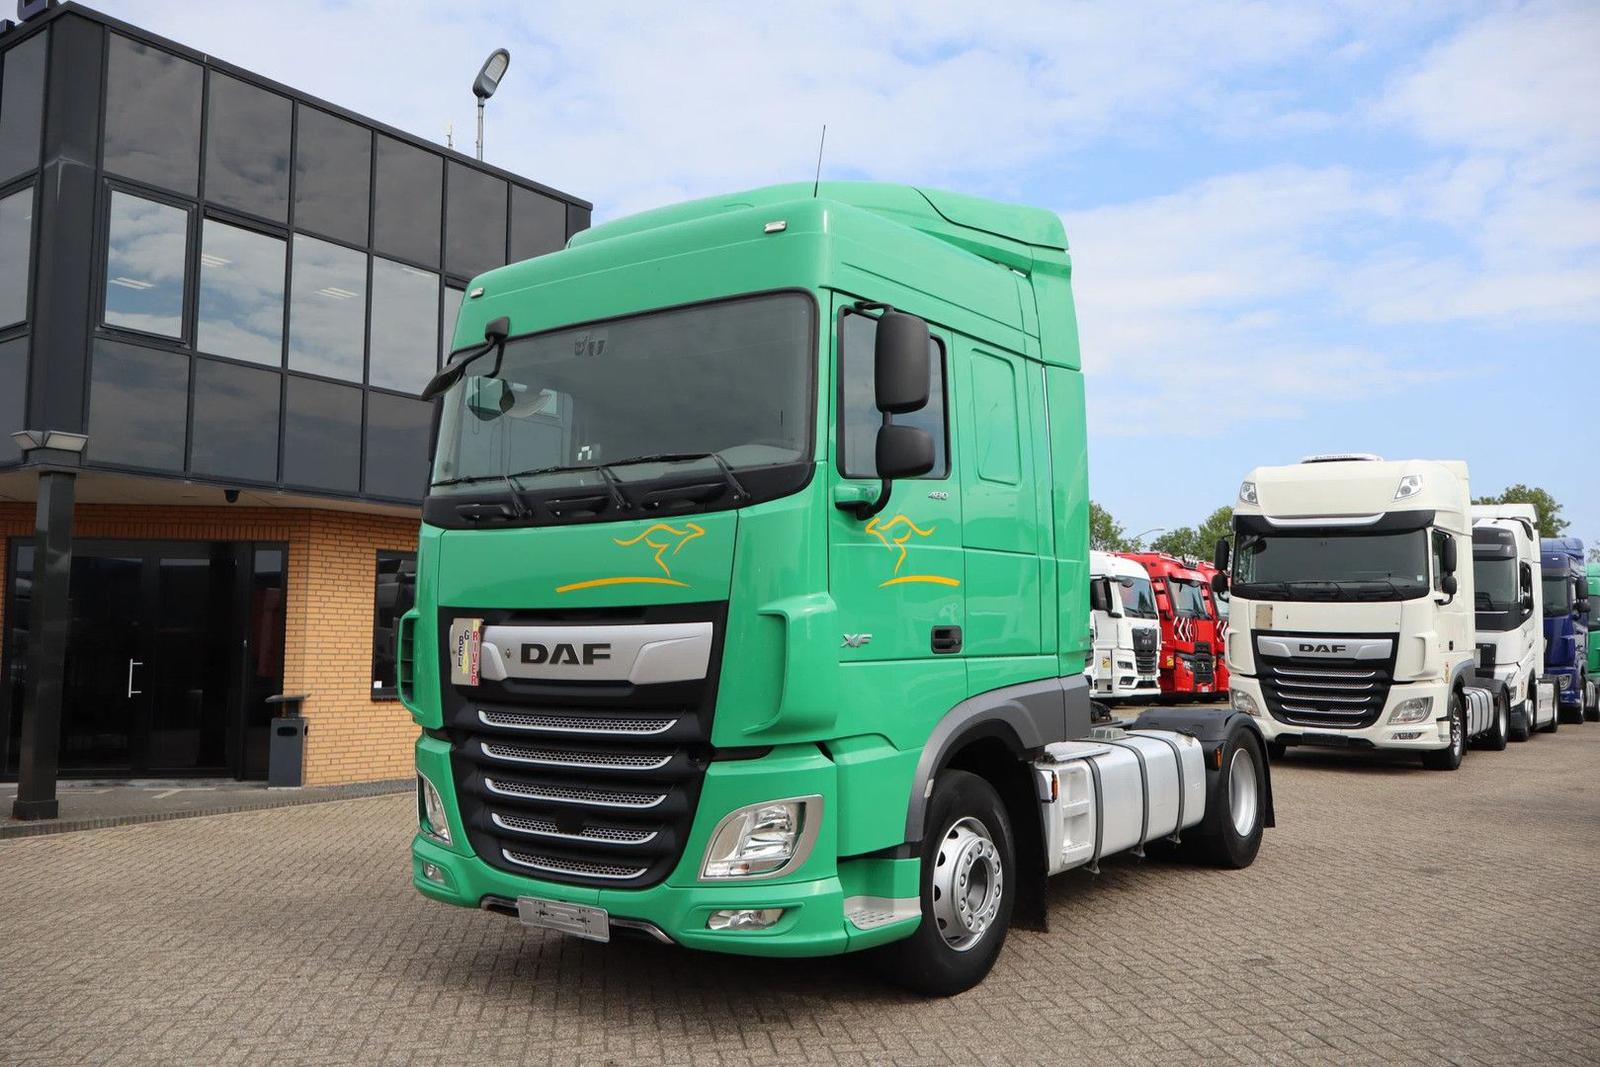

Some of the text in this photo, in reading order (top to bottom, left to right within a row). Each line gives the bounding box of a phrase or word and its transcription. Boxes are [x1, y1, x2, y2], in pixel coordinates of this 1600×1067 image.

[840, 633, 872, 648] XF
[521, 643, 611, 665] DAF
[1299, 644, 1346, 653] DAF
